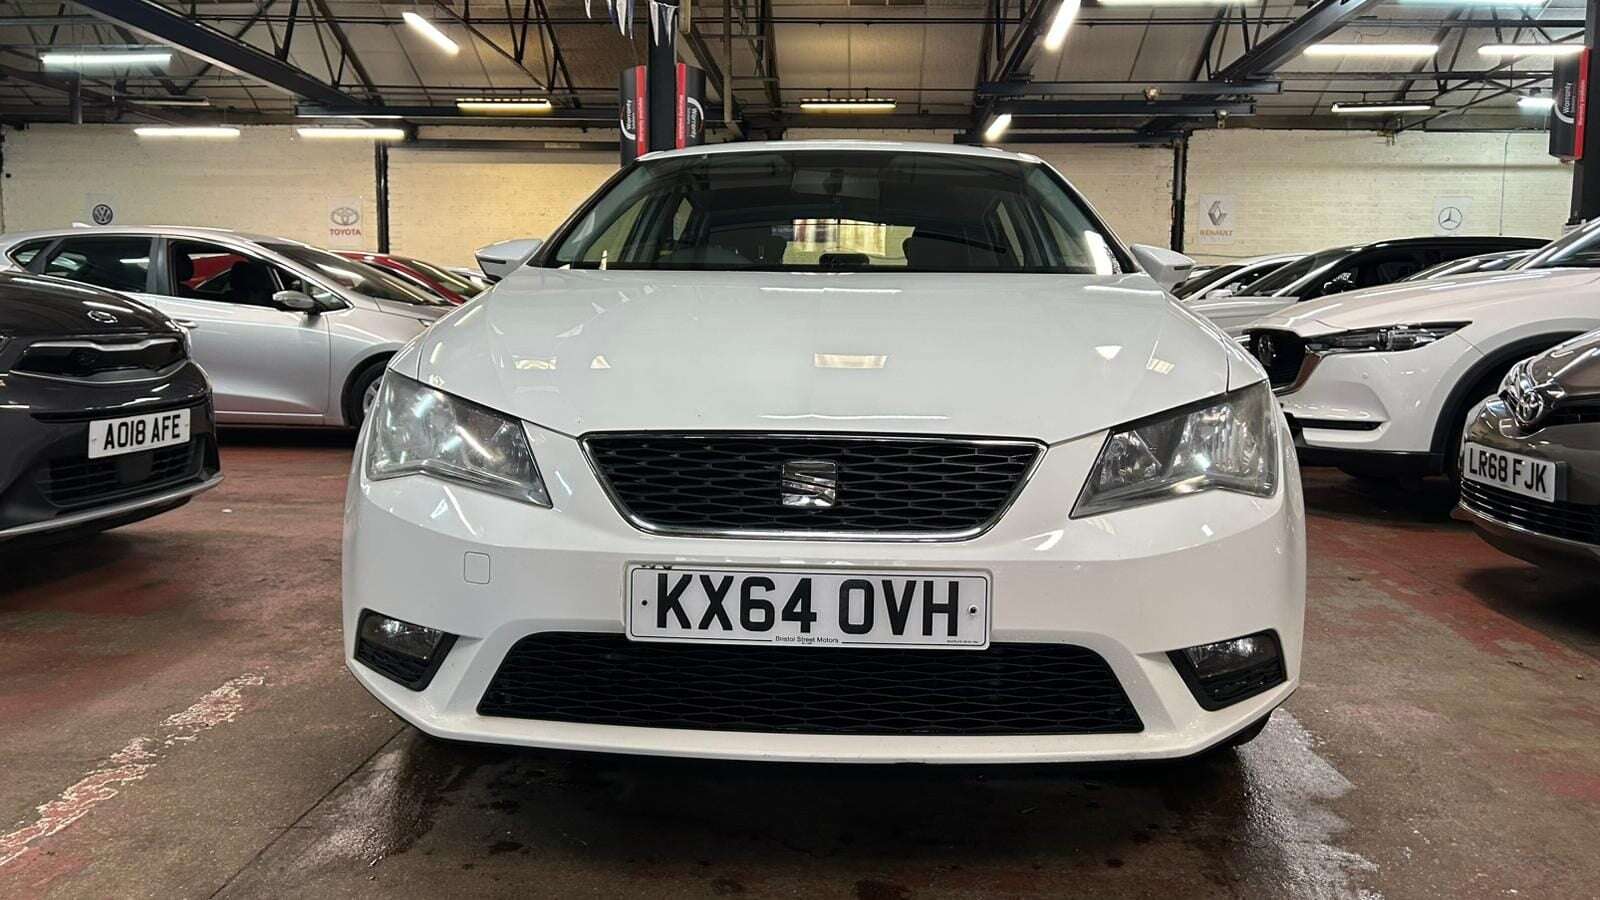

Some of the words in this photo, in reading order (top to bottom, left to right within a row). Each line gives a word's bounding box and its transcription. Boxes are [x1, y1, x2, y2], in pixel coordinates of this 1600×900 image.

[690, 107, 698, 138] Warranty
[330, 228, 361, 236] TOYOTA
[151, 414, 181, 443] AFE
[1469, 447, 1508, 482] LR68
[1512, 458, 1547, 493] FJK
[656, 573, 818, 633] KX64
[838, 578, 959, 636] OVH
